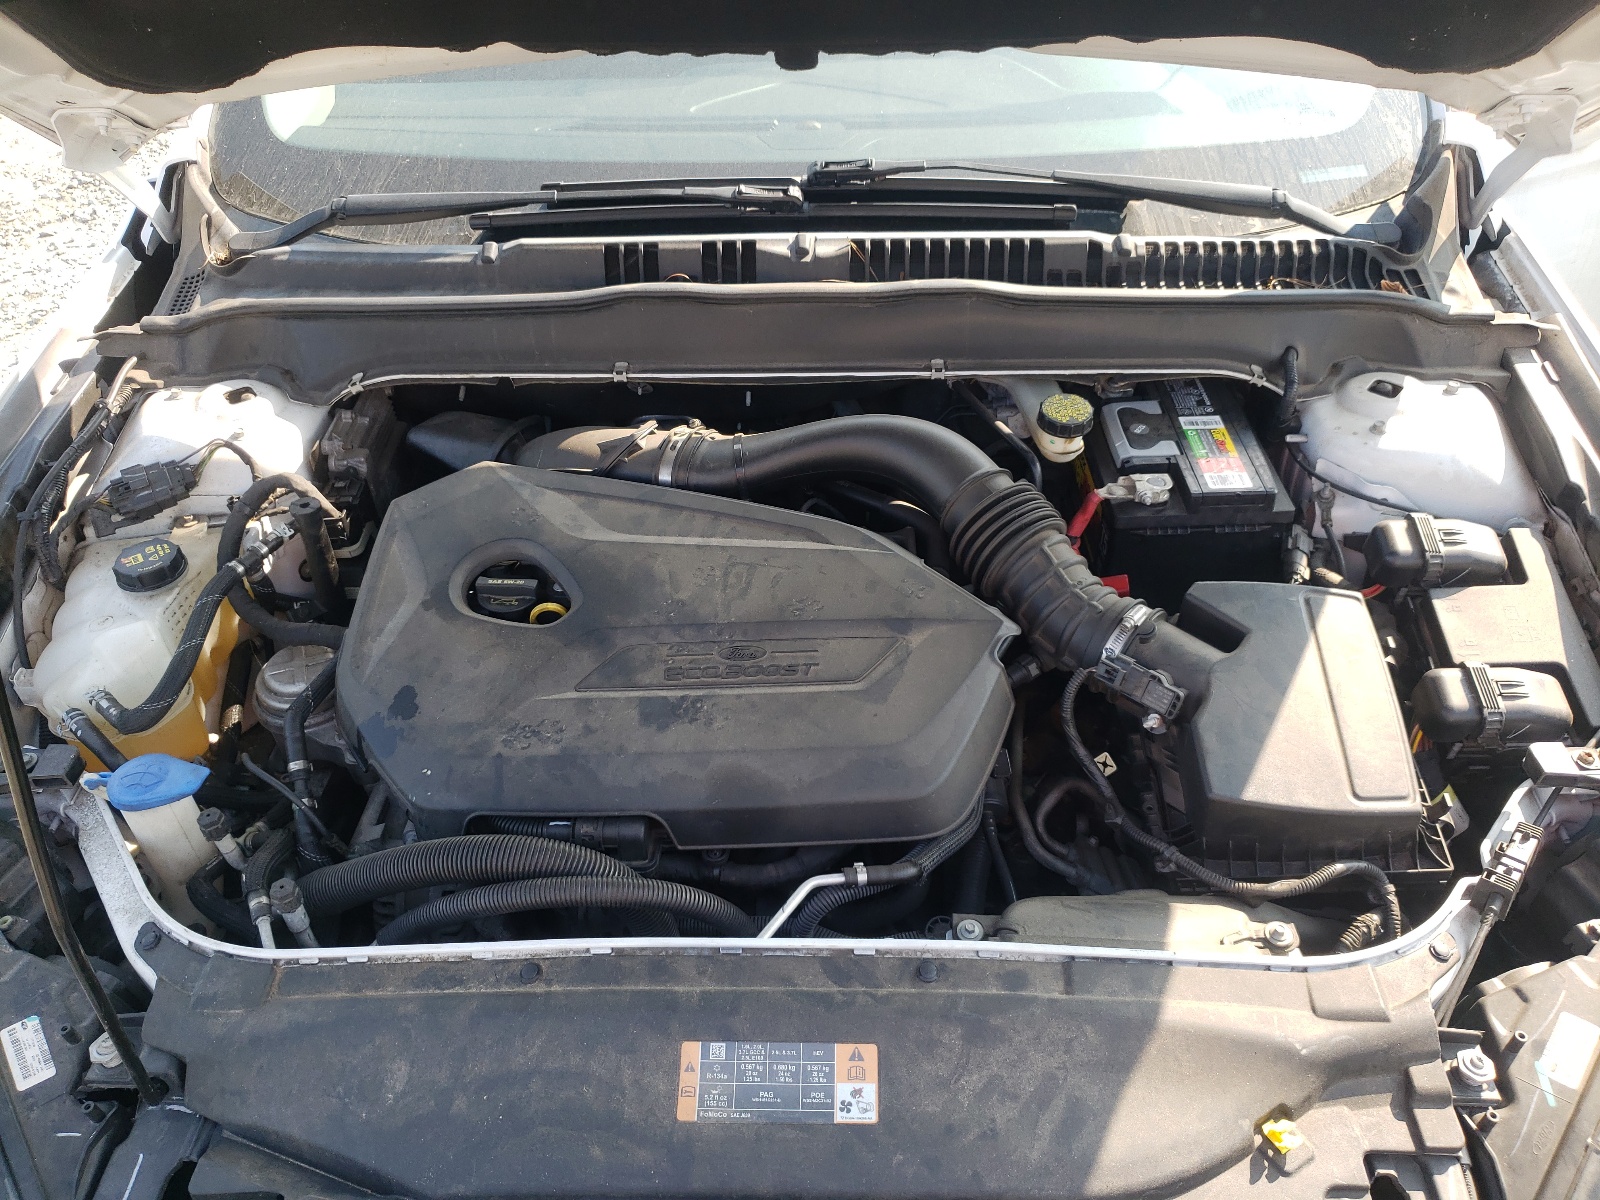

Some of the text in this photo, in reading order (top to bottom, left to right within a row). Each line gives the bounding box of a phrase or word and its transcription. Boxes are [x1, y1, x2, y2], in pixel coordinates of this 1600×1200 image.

[727, 646, 758, 660] Ford
[664, 662, 820, 681] ECOBOOST
[757, 1064, 764, 1072] kg
[788, 1064, 796, 1072] kg
[706, 1072, 728, 1080] R-134a
[700, 1110, 728, 1118] FoMoCo
